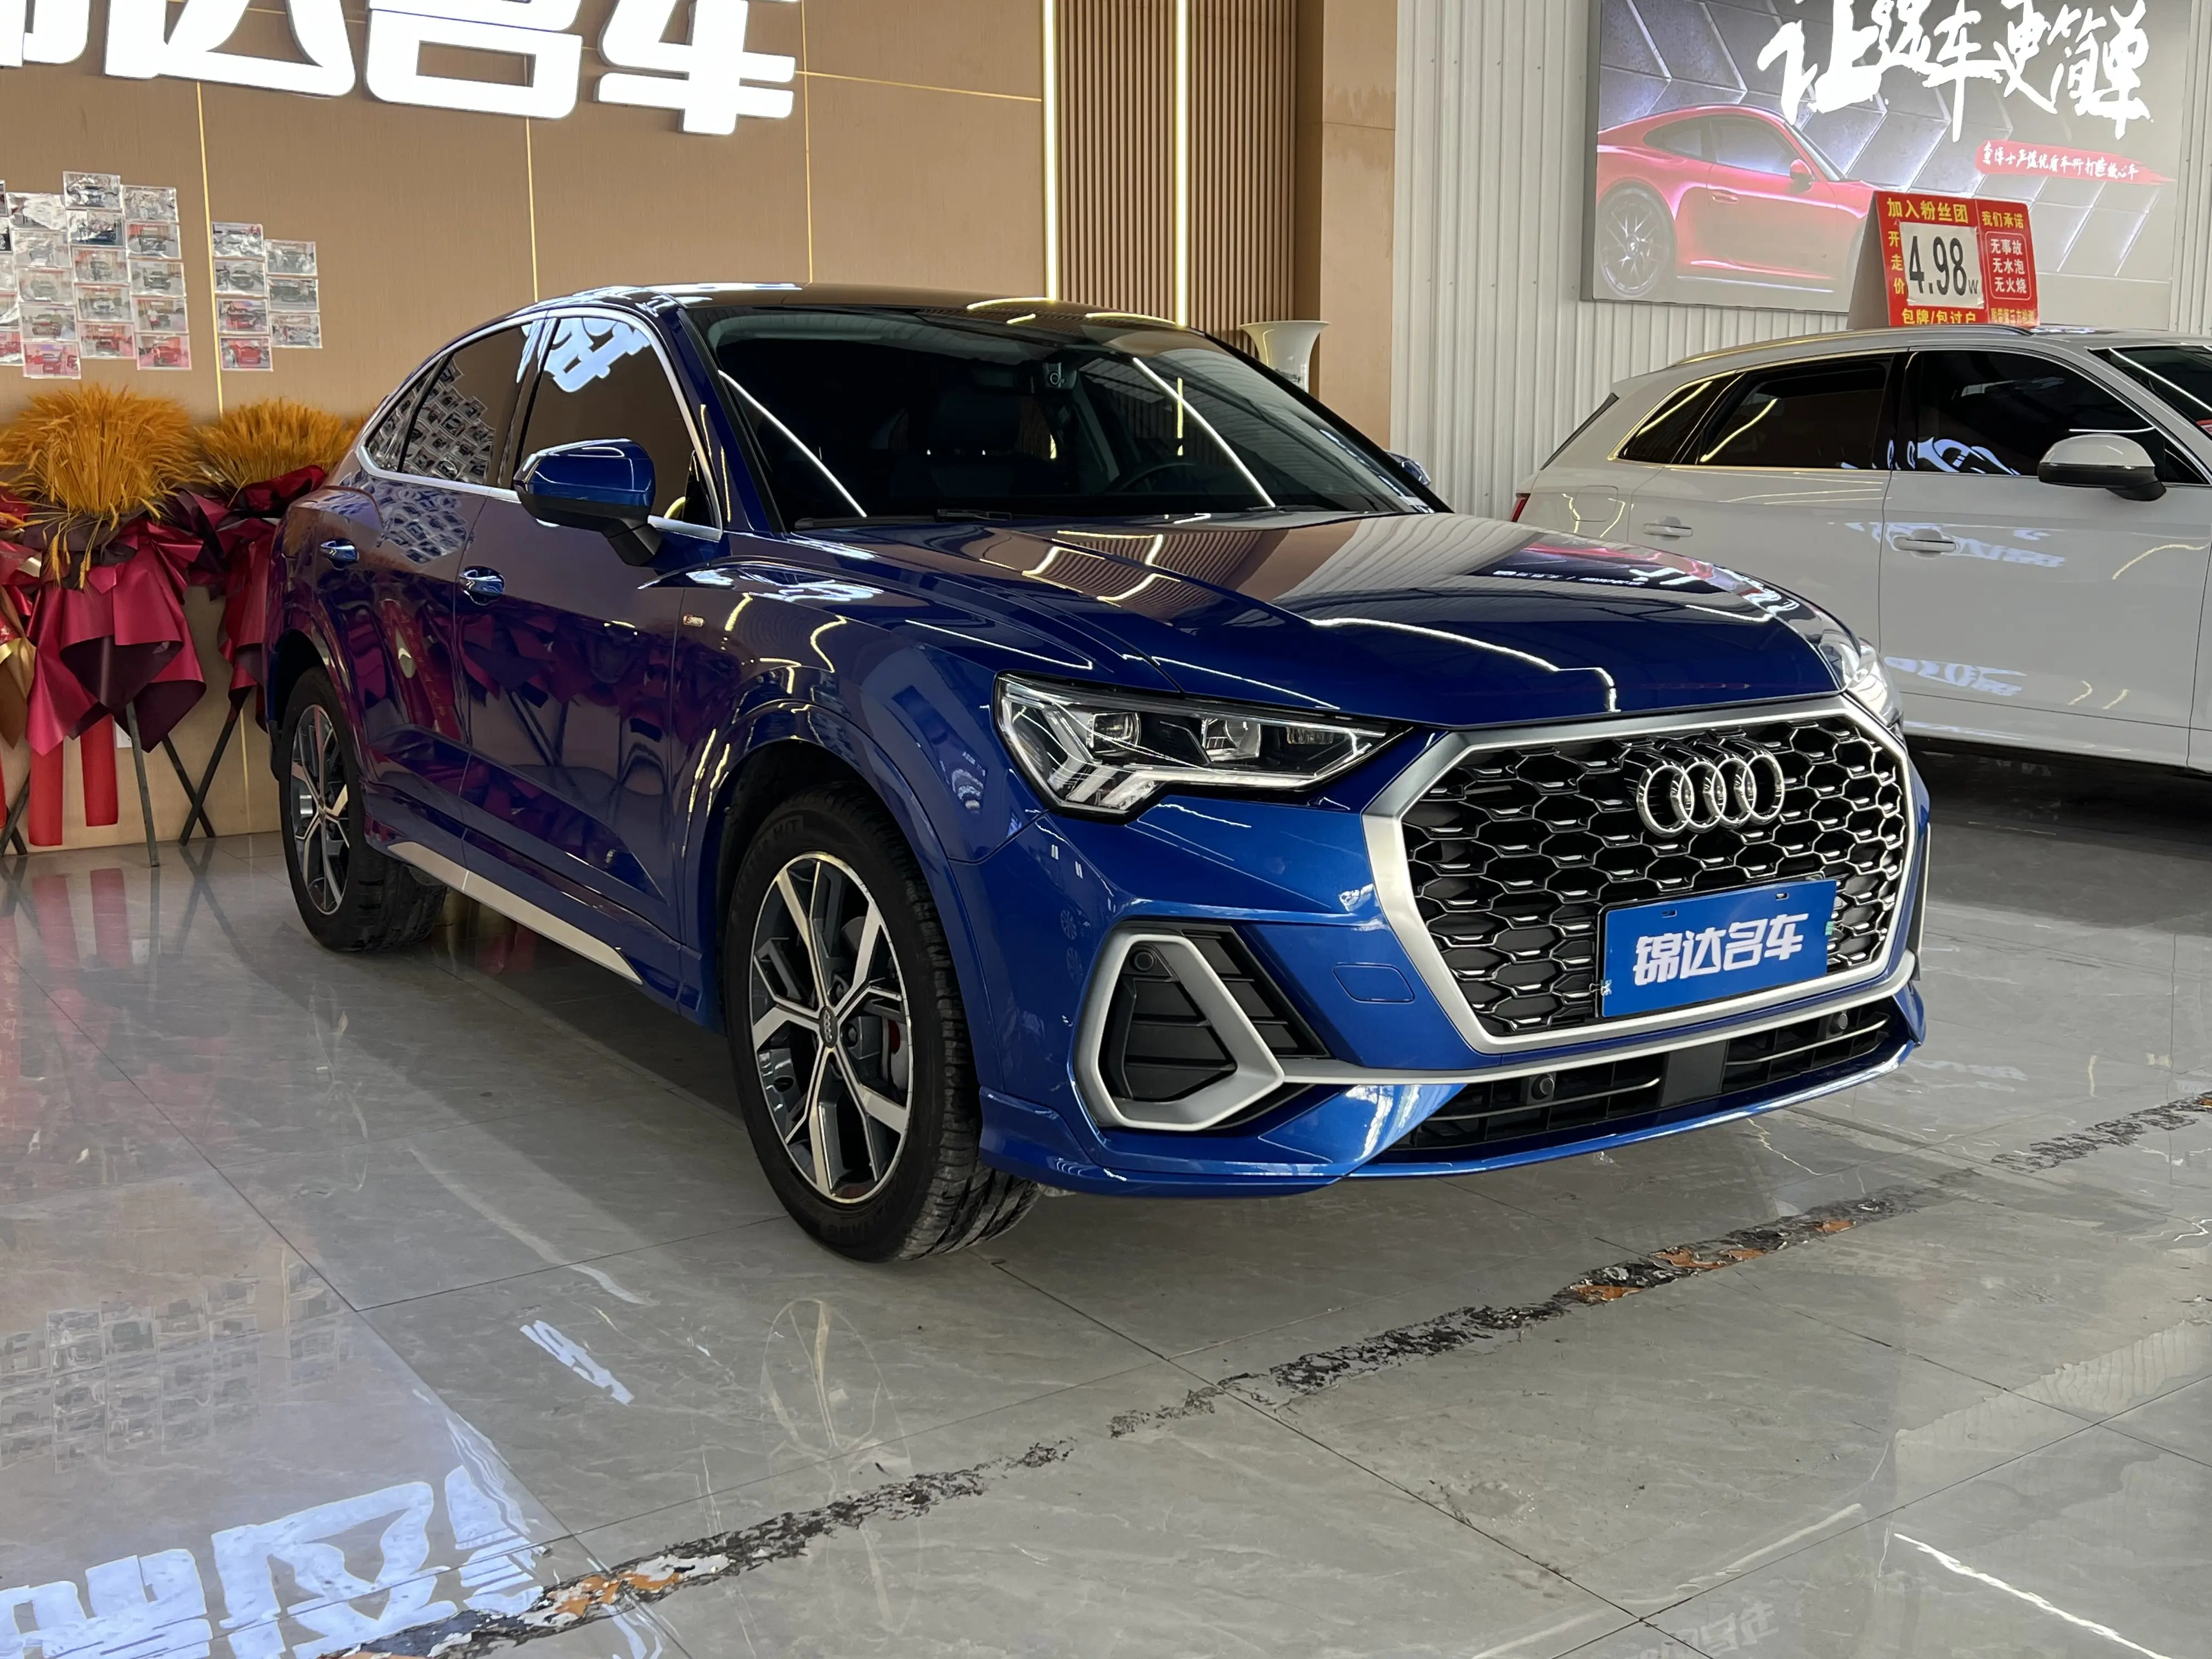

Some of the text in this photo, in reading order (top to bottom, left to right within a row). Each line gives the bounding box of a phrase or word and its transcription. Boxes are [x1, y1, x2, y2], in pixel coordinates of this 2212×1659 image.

[1887, 198, 1969, 224] 加入粉丝团
[1982, 211, 2024, 229] 我们承诺
[1990, 239, 2023, 256] 无事故
[1887, 230, 1905, 295] 开走价
[1992, 258, 2025, 275] 无水泡
[1994, 276, 2027, 294] 无火烧
[1901, 308, 1977, 325] 包牌/包过户
[1633, 913, 1809, 985] 锦达名车
